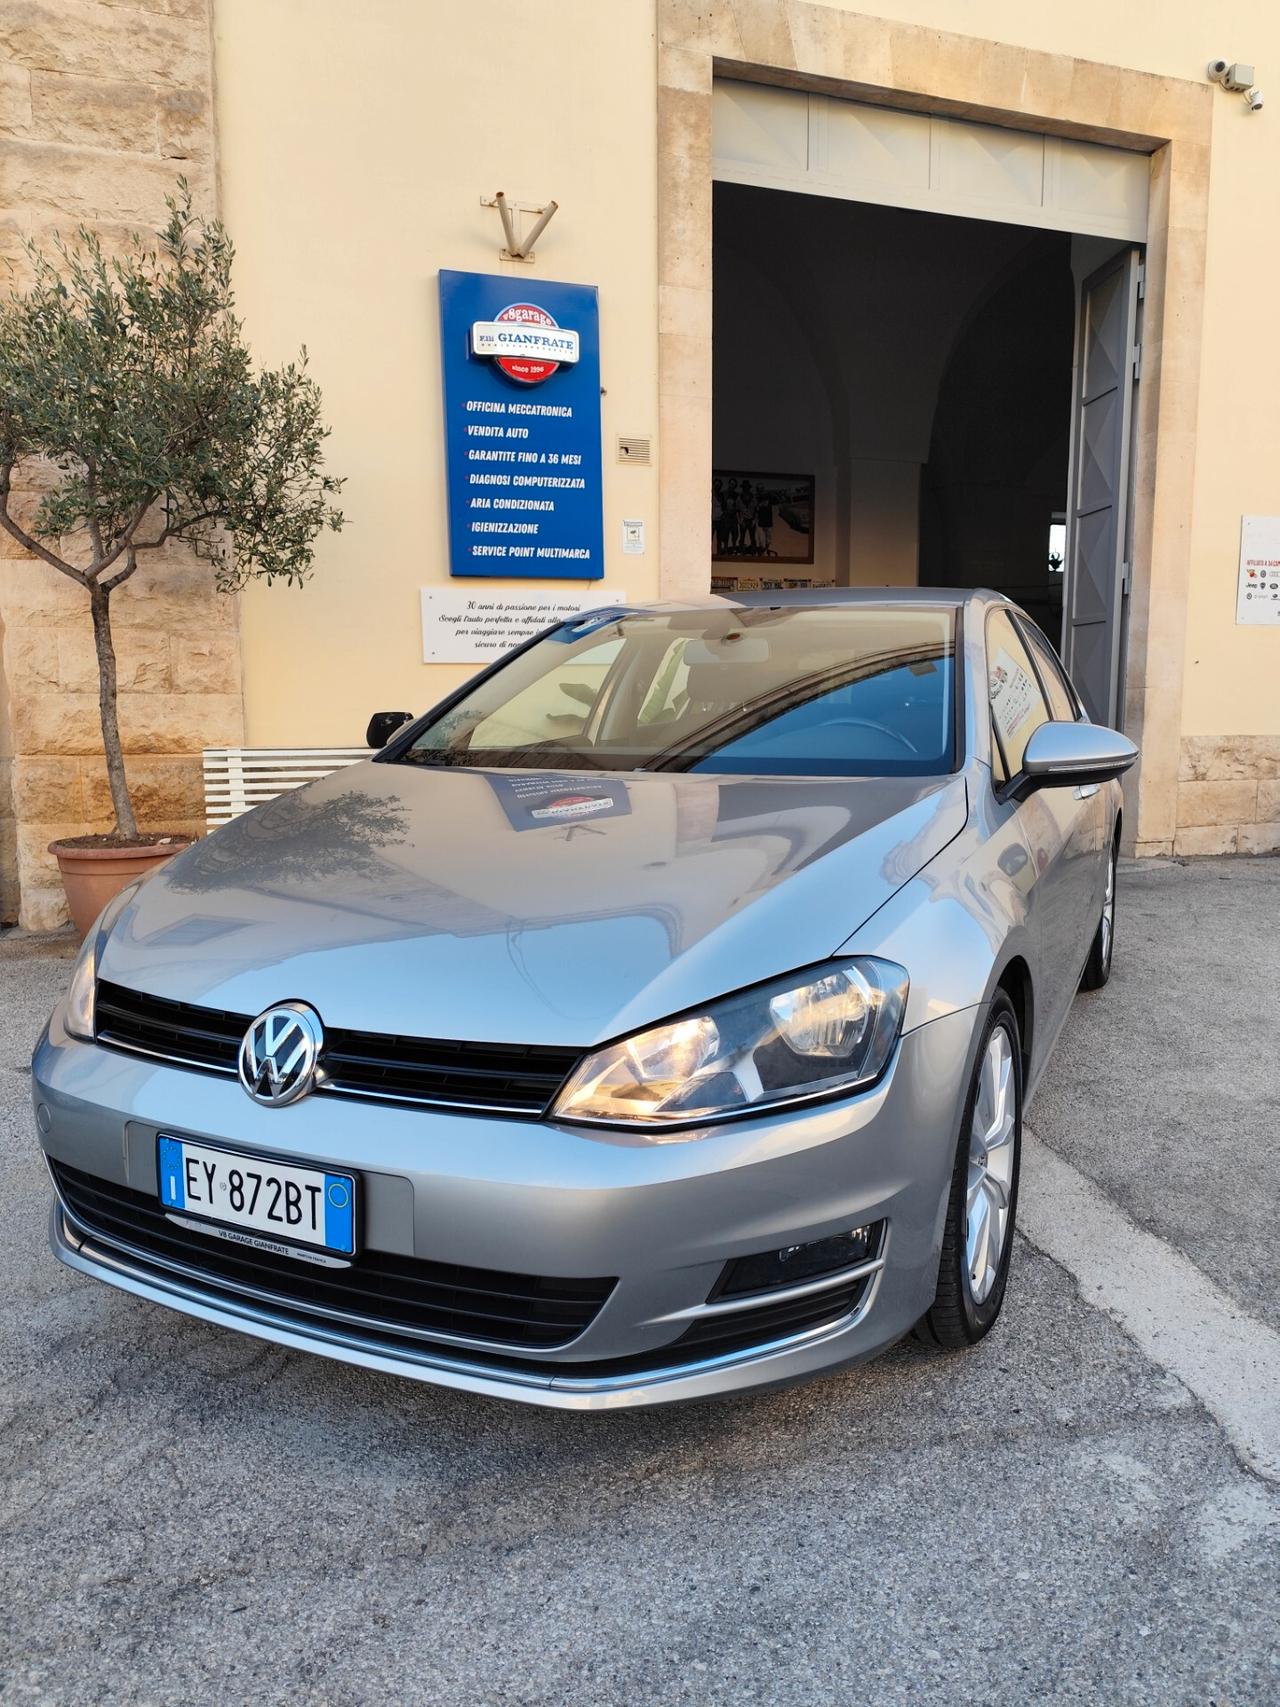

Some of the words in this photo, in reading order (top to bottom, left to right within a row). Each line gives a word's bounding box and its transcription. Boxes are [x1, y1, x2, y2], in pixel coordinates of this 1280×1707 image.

[502, 308, 552, 325] v8garage
[498, 333, 574, 350] GIANFRATE
[511, 365, 529, 373] since
[466, 400, 506, 414] OFFICINA
[508, 403, 573, 417] MECCATRONICA
[467, 425, 504, 437] VENDITA
[506, 428, 529, 439] AUTO
[468, 449, 516, 462] GARANTITE
[518, 452, 538, 463] FINO
[539, 454, 546, 463] A
[548, 454, 558, 464] 36
[561, 454, 581, 465] MESI
[469, 474, 510, 486] DIAGNOSI
[513, 476, 585, 489] COMPUTERIZZATA
[470, 498, 491, 509] ARIA
[493, 499, 554, 511] CONDIZIONATA
[471, 522, 539, 534] IGIENIZZAZIONE
[472, 545, 507, 557] SERVICE
[509, 547, 535, 558] POINT
[537, 548, 590, 559] MULTIMARCA
[466, 600, 477, 610] 30
[478, 602, 495, 610] anni
[496, 602, 503, 610] di
[504, 603, 537, 611] passione
[538, 604, 551, 612] per
[557, 603, 581, 611] motori
[438, 614, 463, 623] Scegli
[484, 616, 512, 624] perfetta
[521, 616, 546, 624] affidati
[455, 628, 469, 636] per
[470, 628, 505, 636] viaggiare
[474, 640, 497, 648] sicuro
[499, 640, 507, 648] di
[185, 1157, 216, 1205] EY
[228, 1169, 322, 1230] 872BT
[218, 1230, 227, 1238] V8
[227, 1232, 253, 1246] GARAGE
[254, 1239, 289, 1255] GIANFRATE
